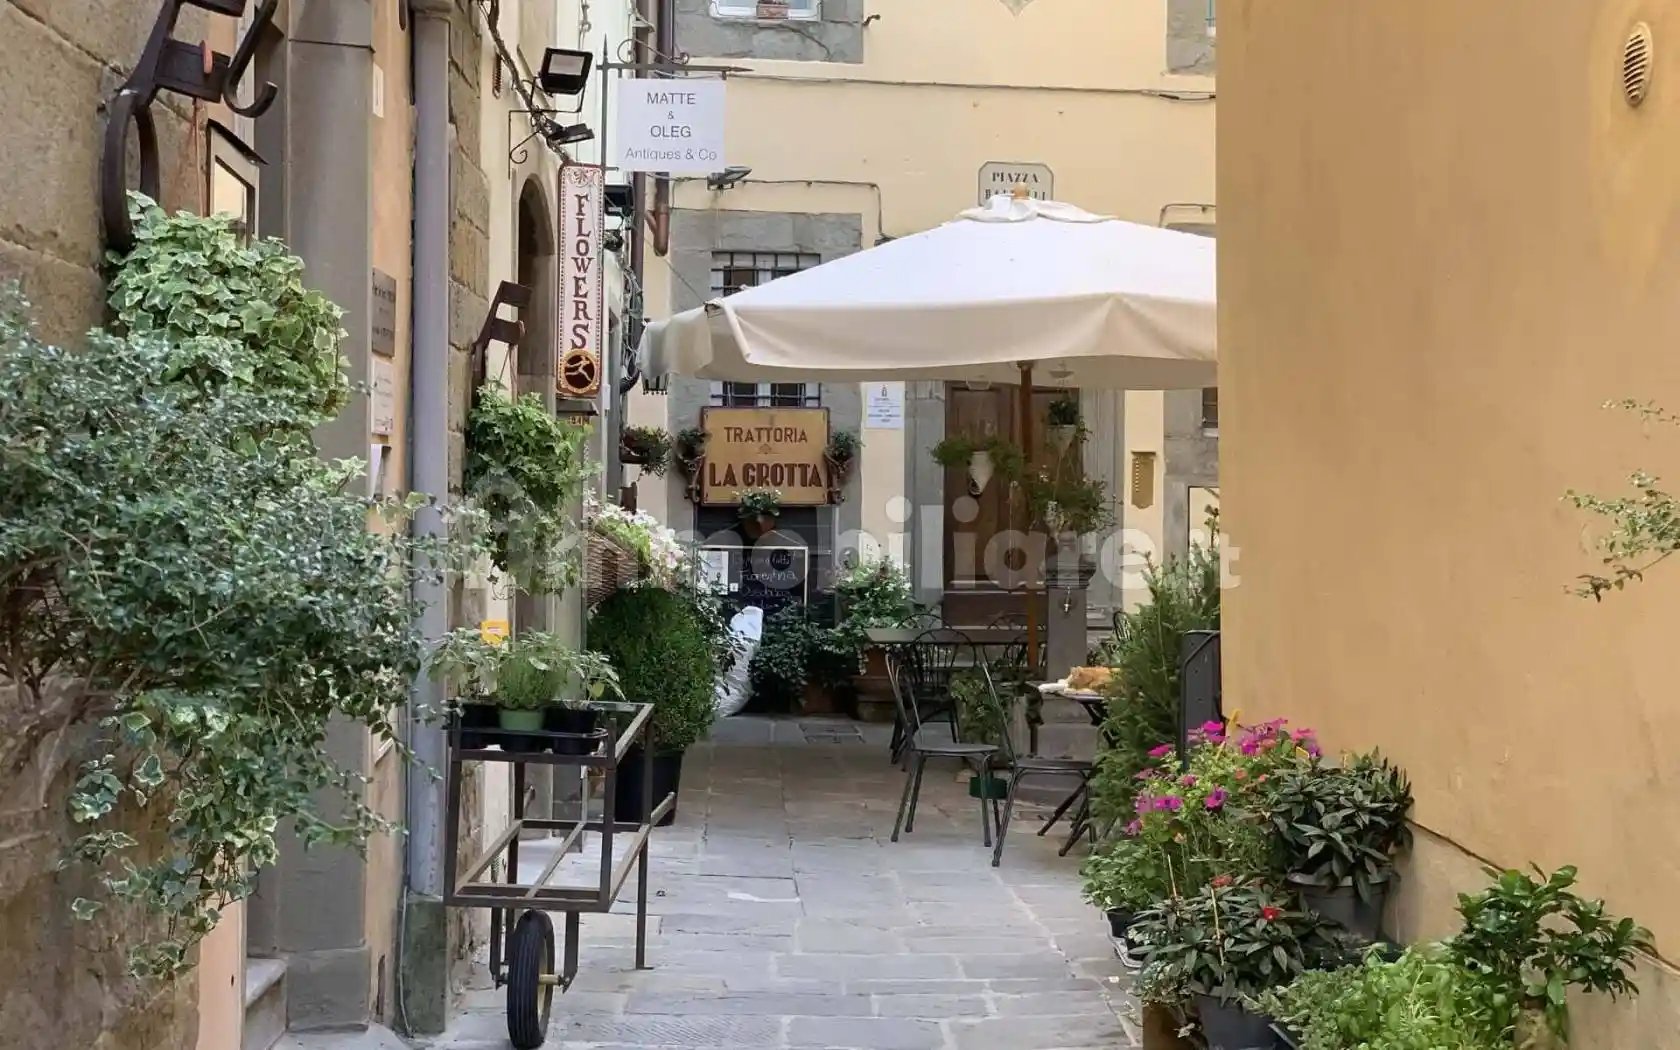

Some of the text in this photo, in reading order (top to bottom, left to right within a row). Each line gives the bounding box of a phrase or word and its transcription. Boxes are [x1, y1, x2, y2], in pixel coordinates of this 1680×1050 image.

[647, 92, 697, 105] MATTE
[667, 110, 675, 120] &
[650, 125, 692, 138] OLEG
[625, 147, 717, 161] Antiques & Co
[992, 171, 1039, 184] PIAZZA
[570, 194, 595, 350] FLOWERS
[724, 426, 808, 443] TRATTORIA
[709, 462, 823, 487] LA GROTTA
